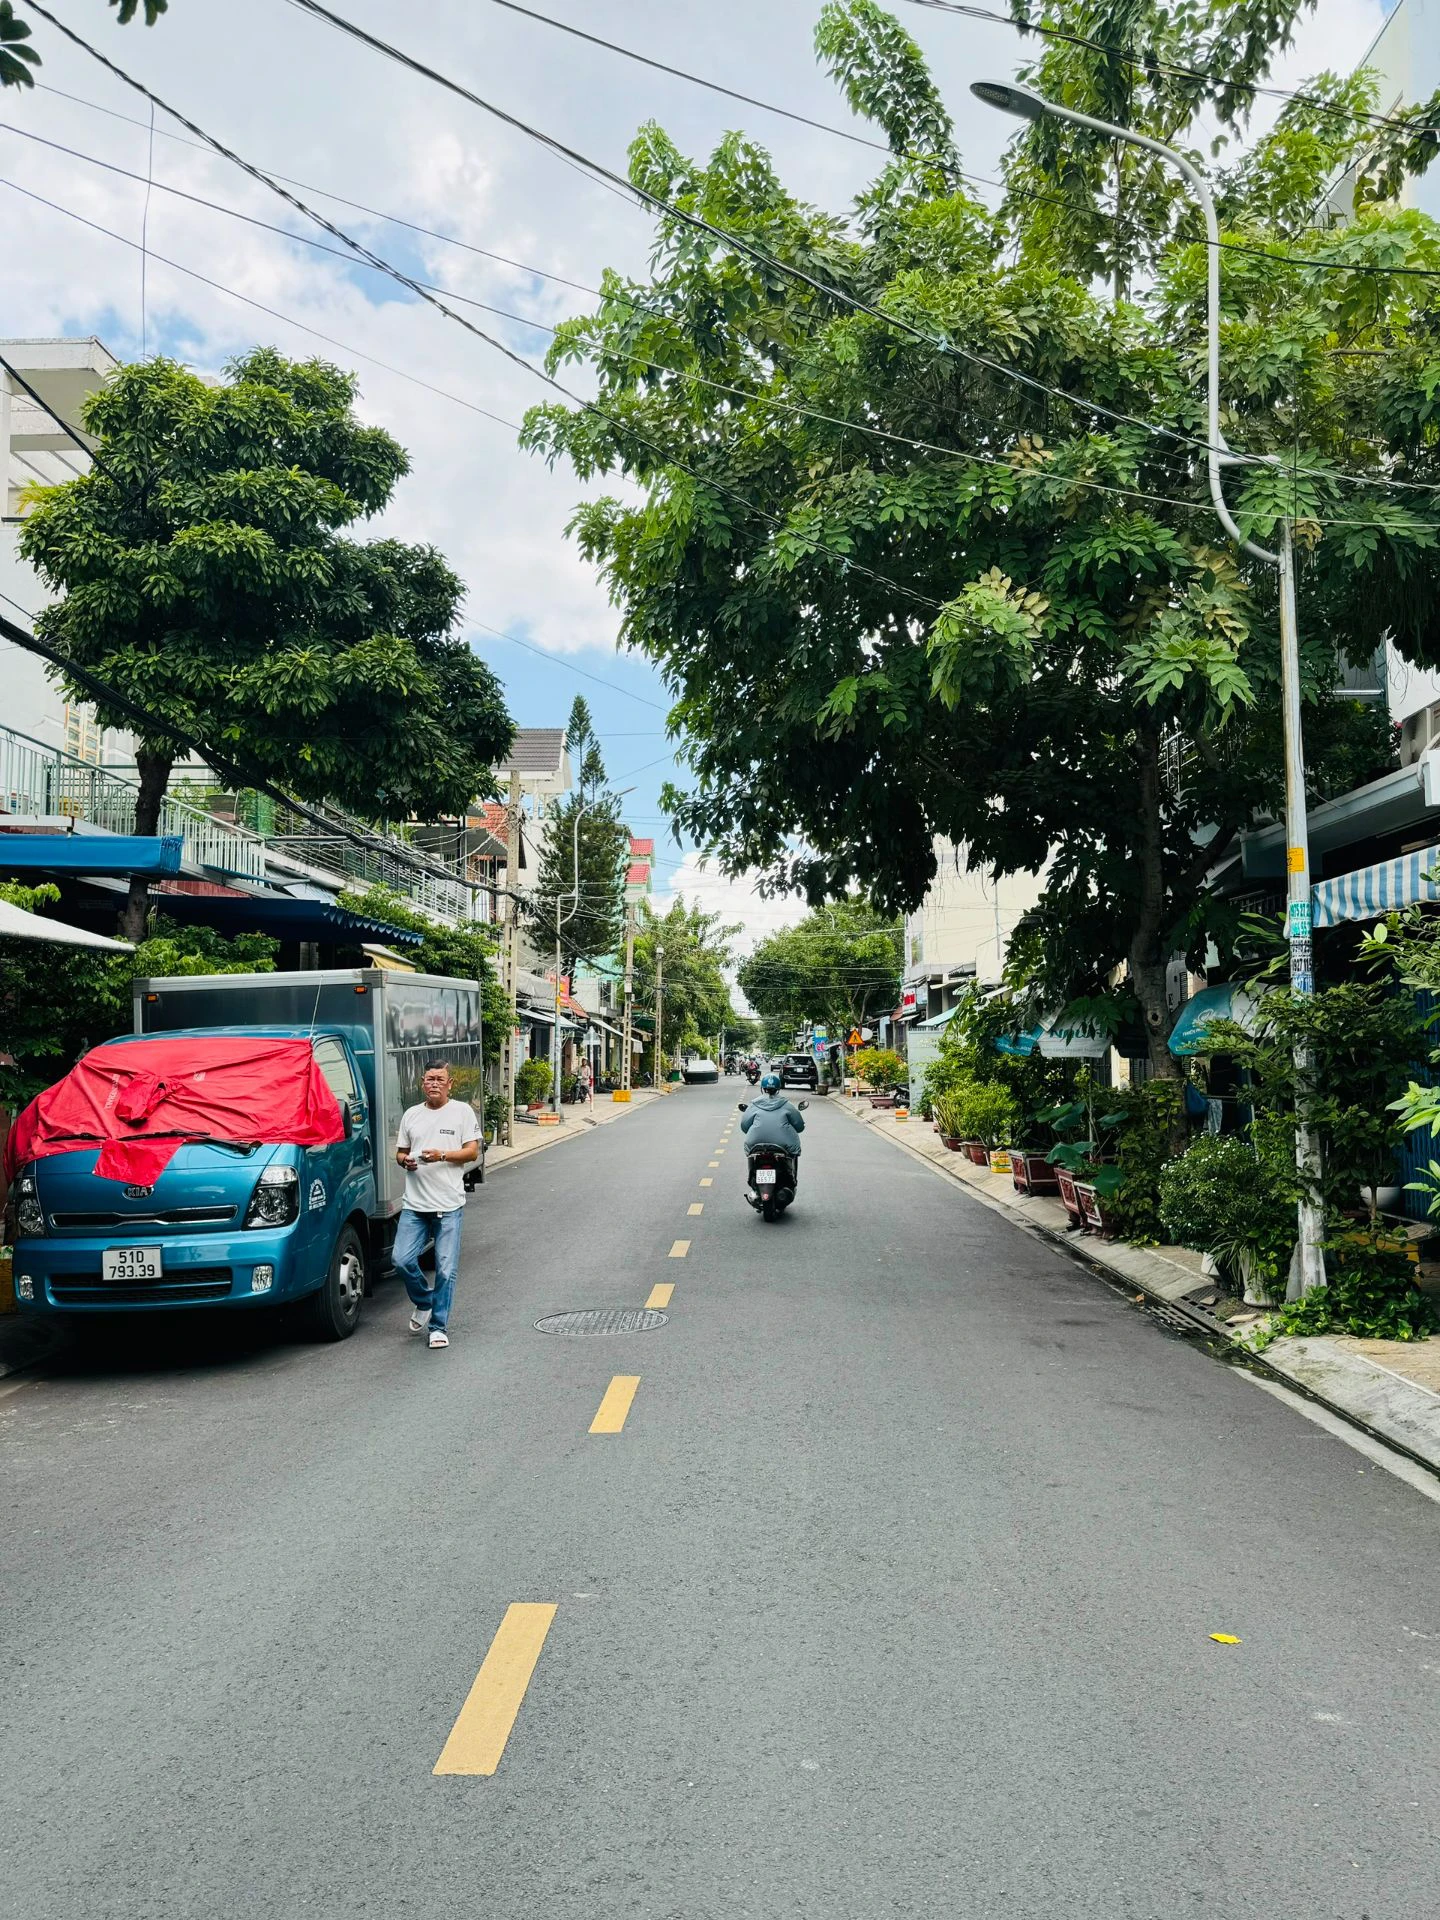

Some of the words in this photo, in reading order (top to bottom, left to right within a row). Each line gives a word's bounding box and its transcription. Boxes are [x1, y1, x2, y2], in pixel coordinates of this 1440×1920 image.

[128, 1187, 148, 1197] KIA
[119, 1251, 144, 1264] 51D
[109, 1264, 155, 1279] 793.39
